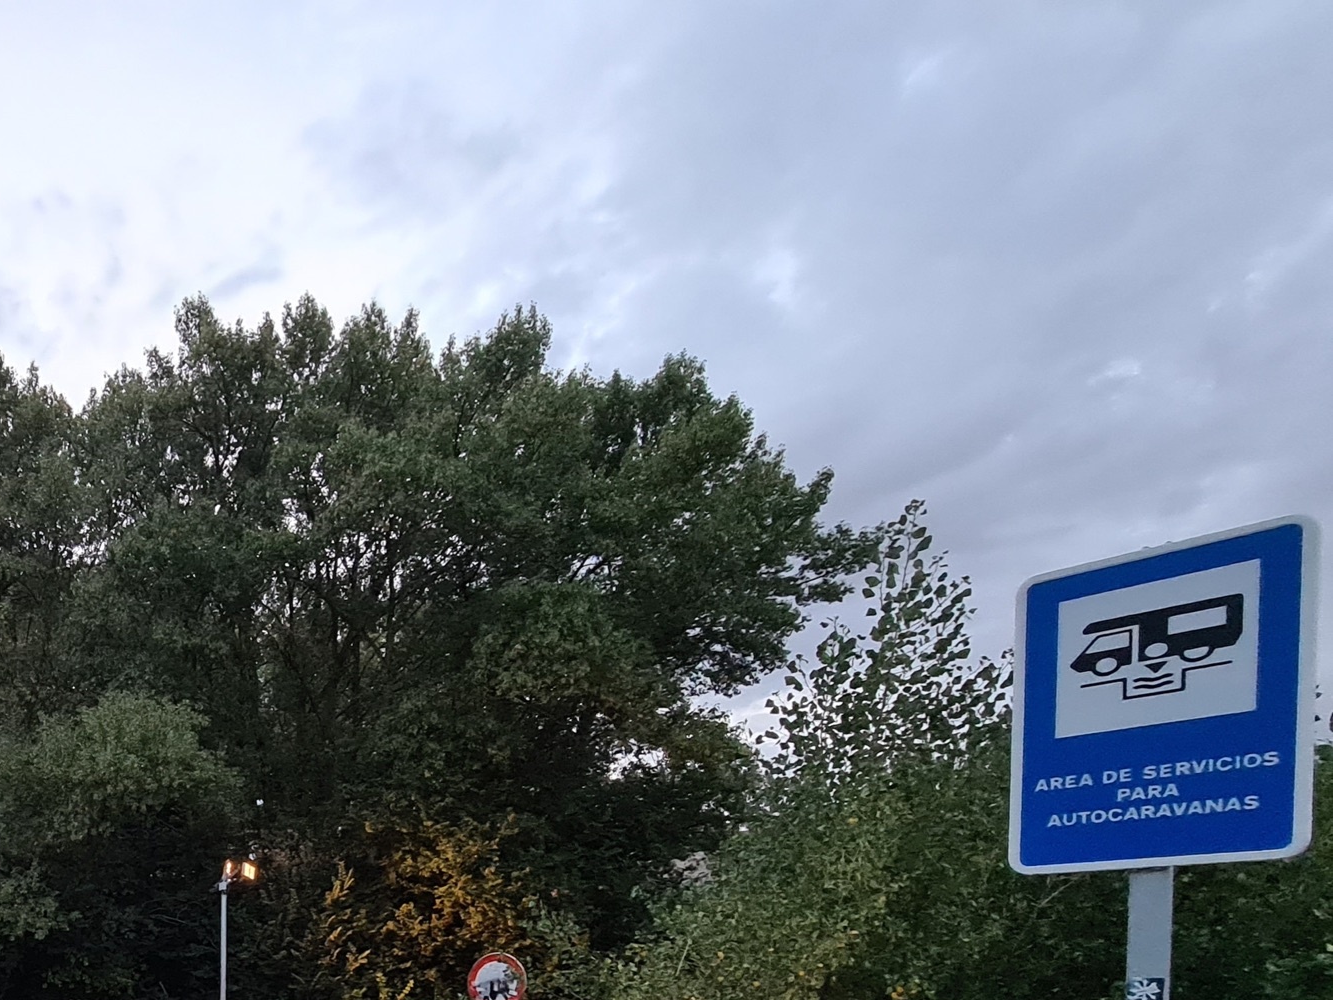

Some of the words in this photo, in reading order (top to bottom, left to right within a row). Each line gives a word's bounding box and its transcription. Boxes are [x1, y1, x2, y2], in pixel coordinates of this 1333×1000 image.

[1034, 773, 1093, 792] AREA
[1102, 768, 1132, 785] DE
[1142, 751, 1280, 780] SERVICIOS
[1117, 783, 1179, 802] PARA
[1046, 795, 1260, 828] AUTOCARAVANAS
